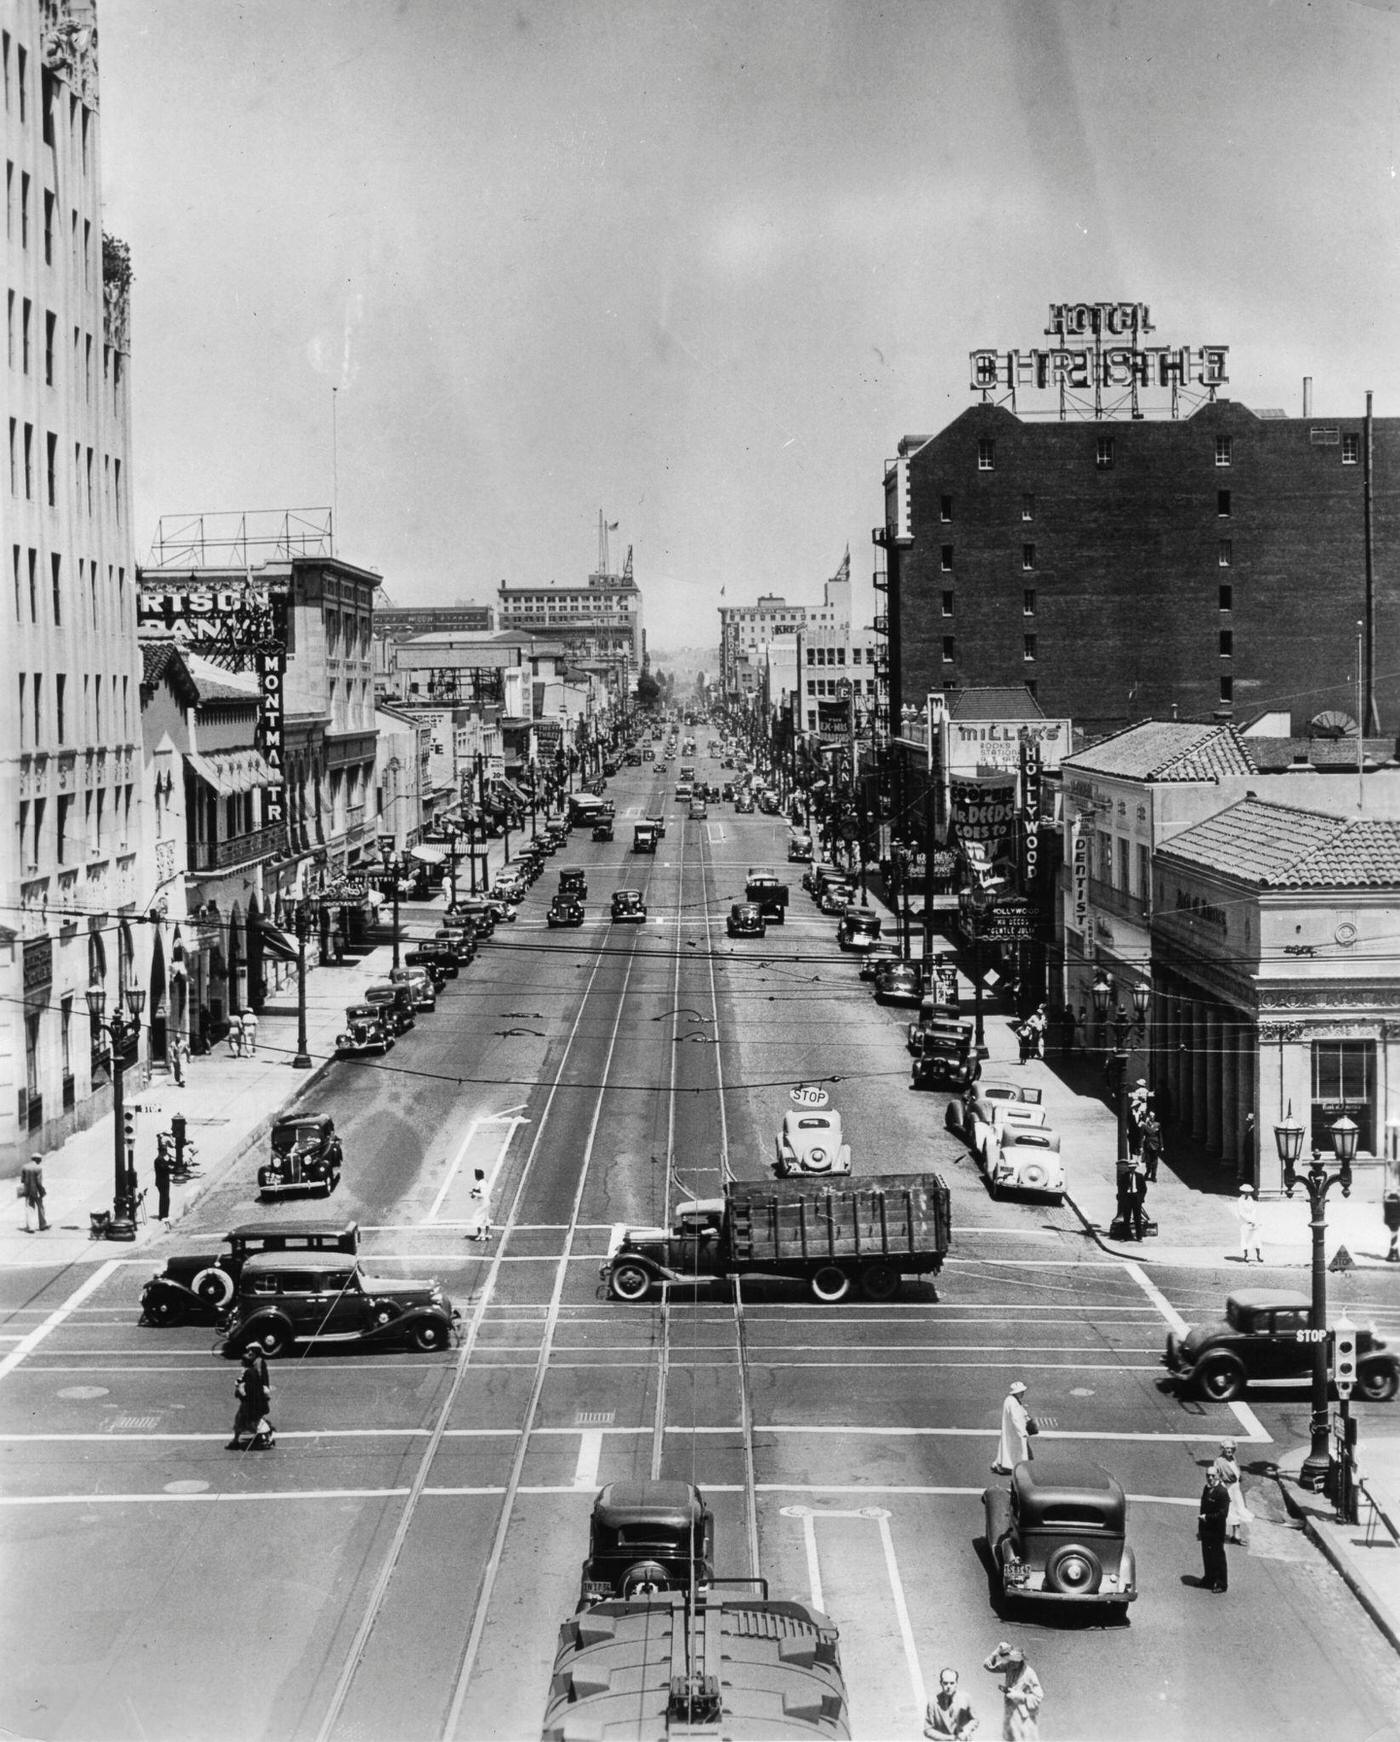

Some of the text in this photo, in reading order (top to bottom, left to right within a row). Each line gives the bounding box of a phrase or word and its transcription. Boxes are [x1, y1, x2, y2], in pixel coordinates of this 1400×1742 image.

[1047, 302, 1154, 334] HOTEL
[969, 345, 1229, 390] CHRISTIE
[264, 655, 282, 821] MONTMATR
[968, 803, 1014, 824] DEEDS
[1024, 747, 1040, 879] HOLLYWOOD
[793, 1088, 826, 1103] STOP
[1295, 1328, 1327, 1342] STOP
